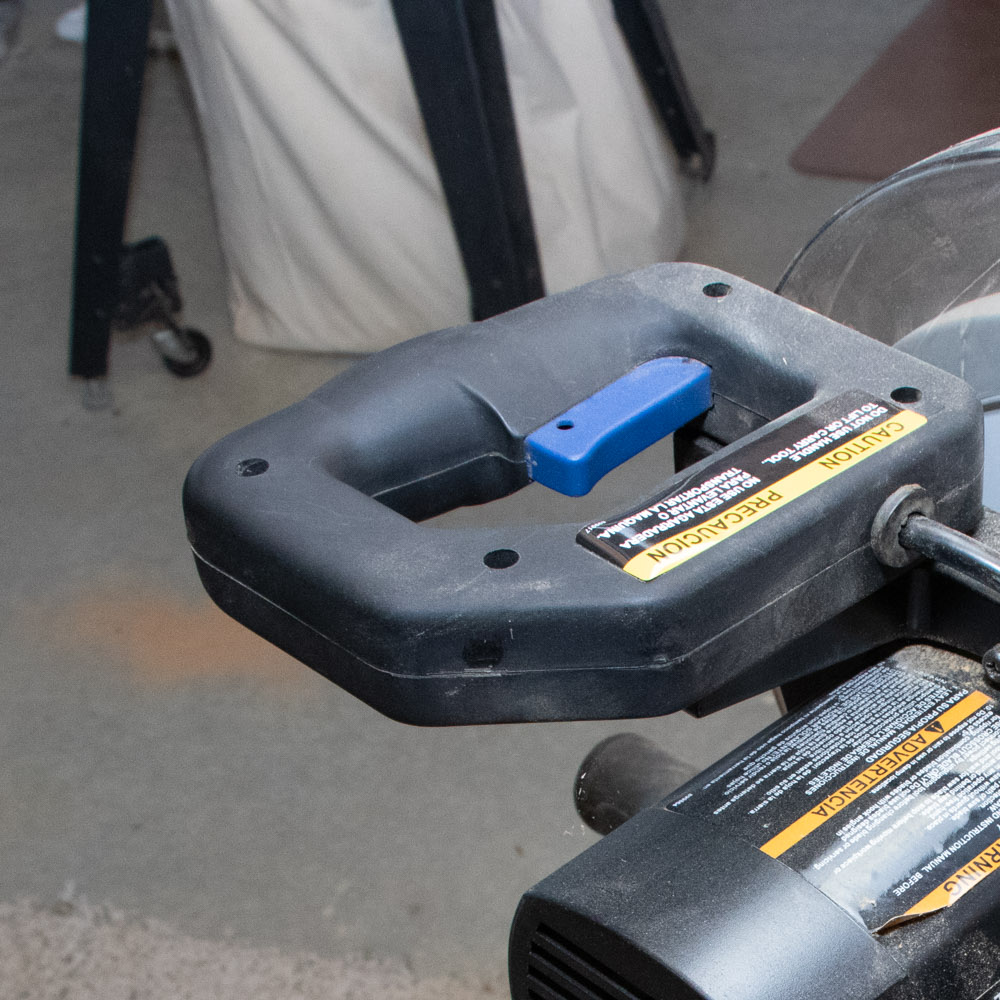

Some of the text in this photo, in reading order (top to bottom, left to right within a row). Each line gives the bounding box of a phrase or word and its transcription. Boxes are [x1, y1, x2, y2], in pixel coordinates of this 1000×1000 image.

[838, 409, 865, 423] LIFT
[857, 401, 878, 412] TO
[788, 406, 888, 461] DO NOT USE HANDLE
[823, 420, 845, 431] OR
[790, 428, 829, 450] CARRY
[818, 420, 906, 470] CAUTION
[662, 466, 742, 507] TRANSPORTAR
[718, 471, 752, 490] PARA
[739, 476, 761, 489] NO
[665, 486, 723, 515] LEVANTAR
[717, 485, 745, 501] USE
[648, 502, 667, 514] LA
[691, 496, 724, 515] ESTA
[617, 509, 697, 550] AGARRADERA
[645, 489, 782, 563] PRECAUCION
[923, 685, 947, 702] ANTES
[945, 688, 969, 704] PARA
[881, 706, 917, 732] ACCIONAR
[900, 700, 935, 725] ENTIENDA
[907, 709, 939, 732] PROPIA
[849, 736, 877, 755] SIERRA
[863, 729, 912, 764] SEGURIDAD
[867, 728, 896, 749] MANUAL
[803, 754, 860, 795] INSTRUCCIONES
[811, 733, 929, 819] ADVERTENCIA
[948, 816, 994, 852] INSTRUCTION
[922, 849, 951, 873] MANUAL
[892, 871, 922, 896] BEFORE
